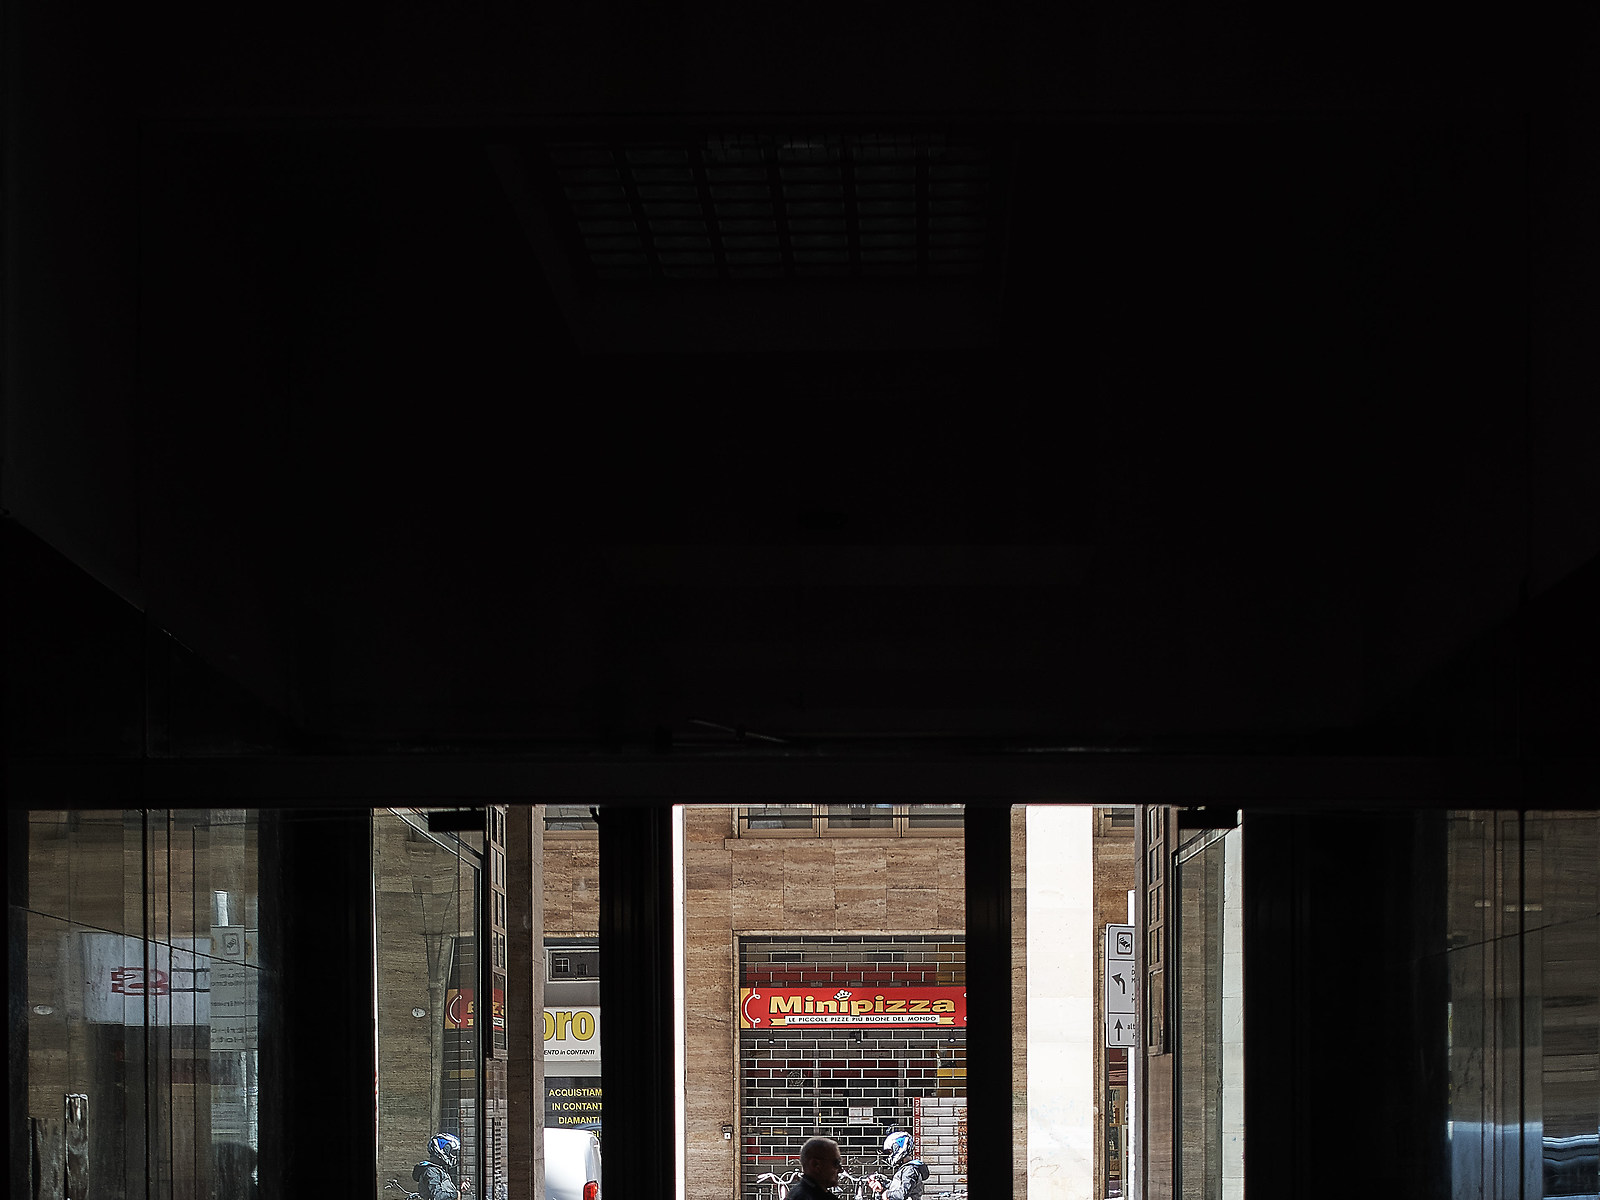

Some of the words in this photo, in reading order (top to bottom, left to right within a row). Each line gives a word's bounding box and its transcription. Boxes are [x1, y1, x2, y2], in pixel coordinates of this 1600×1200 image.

[769, 995, 956, 1016] Minipizza
[551, 1102, 561, 1111] IN
[558, 1116, 600, 1124] DIAMANTI
